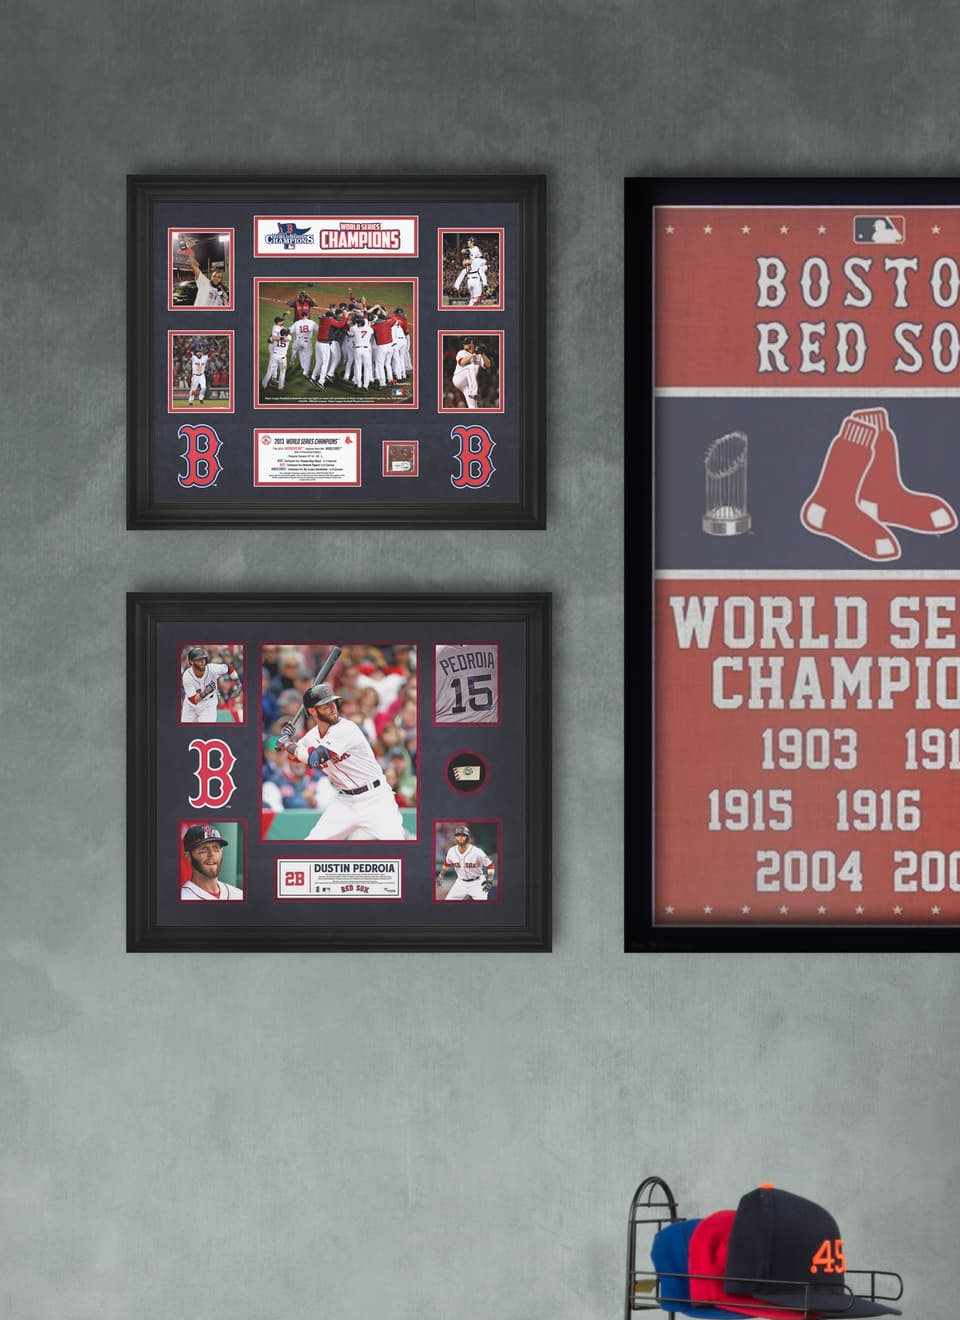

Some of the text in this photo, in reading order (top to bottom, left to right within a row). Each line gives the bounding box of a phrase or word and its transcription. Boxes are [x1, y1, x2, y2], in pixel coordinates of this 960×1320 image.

[265, 234, 314, 244] CHAMPIONS
[320, 230, 401, 249] CHAMPIONS
[340, 223, 381, 231] WORLD SERIES
[299, 324, 309, 334] 18
[361, 330, 368, 339] 7
[276, 340, 287, 348] 15
[755, 321, 868, 374] RED
[178, 423, 224, 488] B
[450, 424, 497, 489] B
[669, 595, 868, 650] WORLD
[439, 651, 495, 676] PEDROIA
[451, 674, 493, 714] 15
[761, 727, 858, 771] 1903
[188, 738, 237, 809] B
[707, 789, 793, 832] 1915
[836, 789, 921, 832] 1916
[285, 871, 305, 886] 2B
[314, 863, 395, 873] DUSTIN PEDROIA
[755, 850, 863, 893] 2004
[341, 884, 354, 893] RED
[356, 884, 370, 893] SOX
